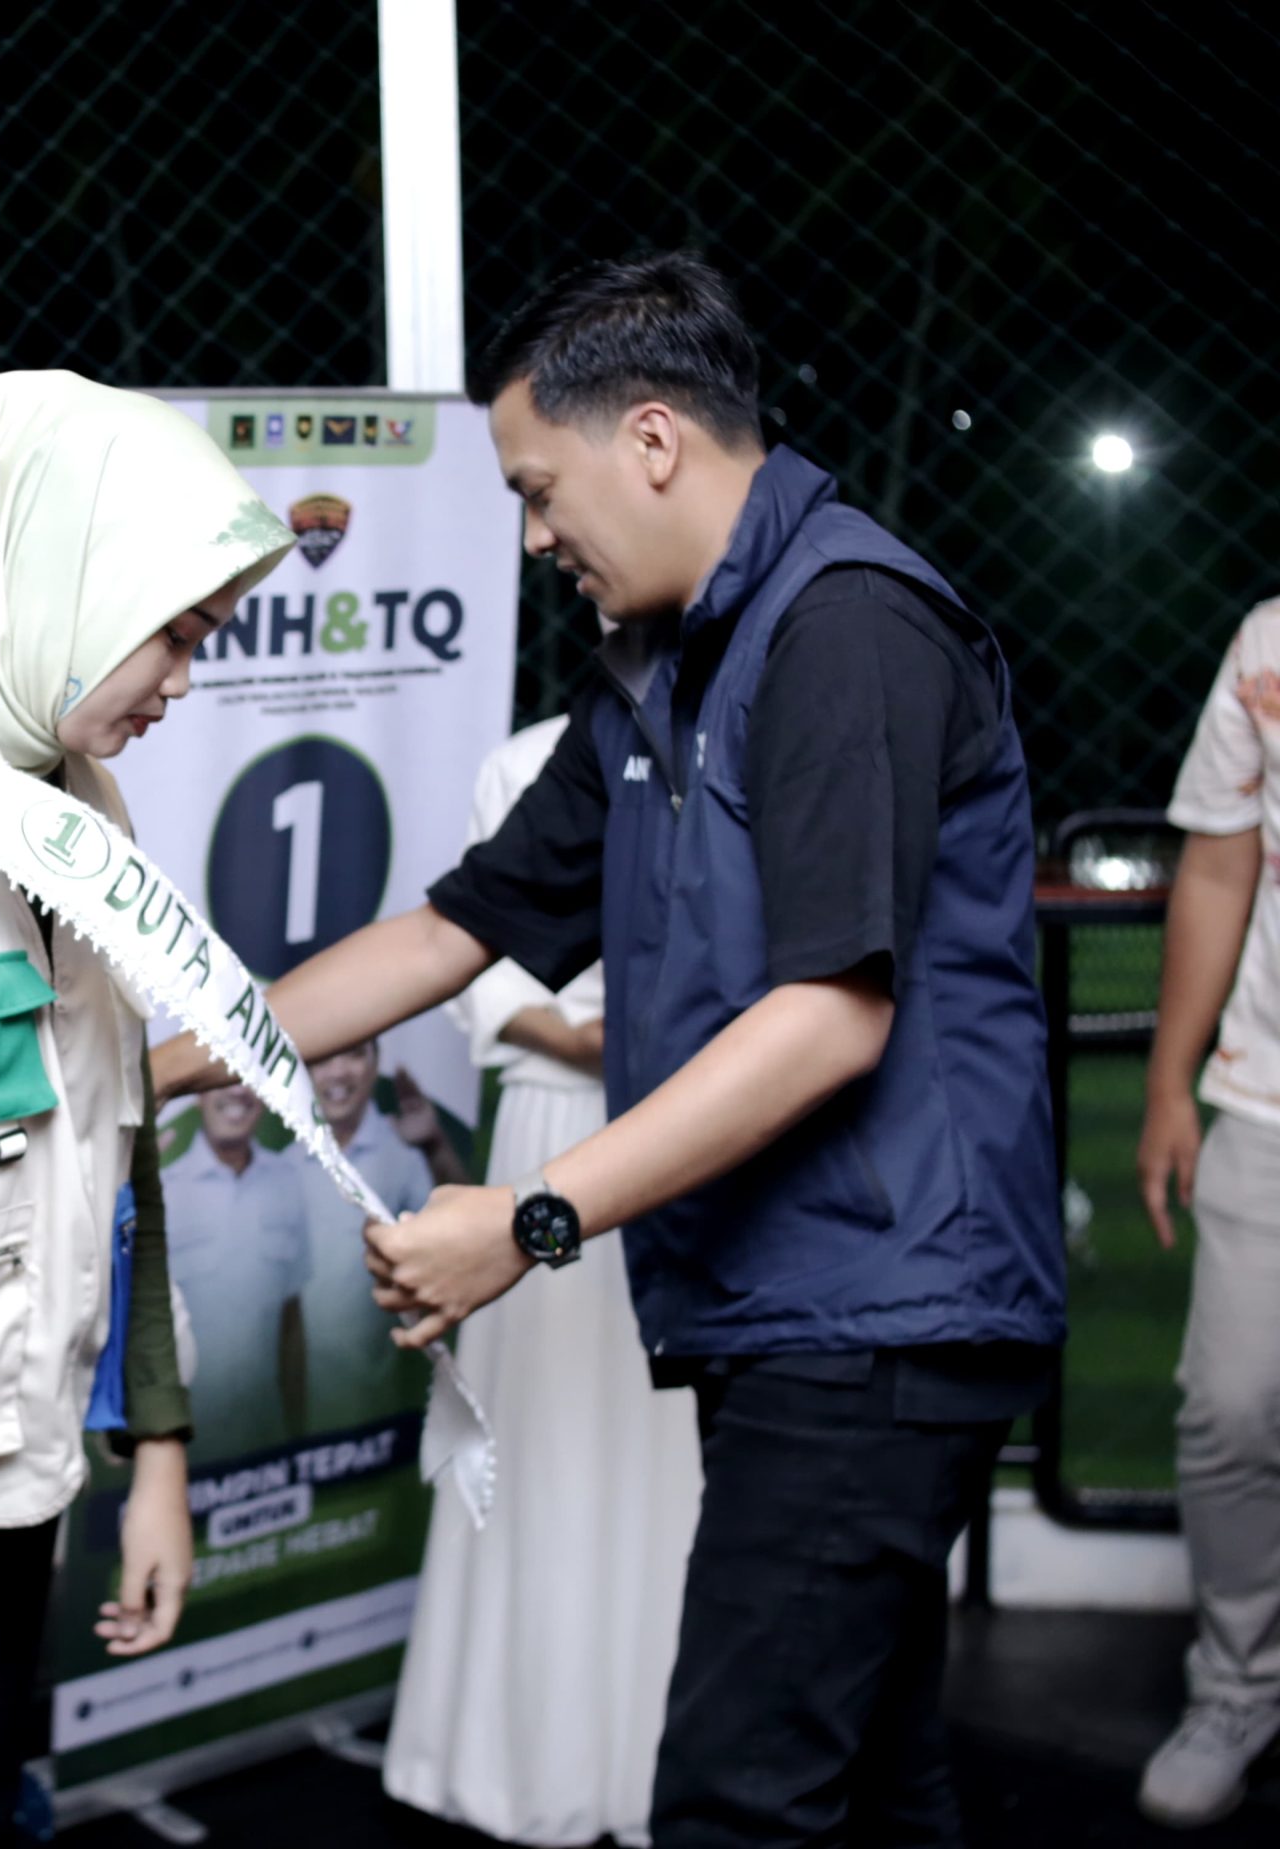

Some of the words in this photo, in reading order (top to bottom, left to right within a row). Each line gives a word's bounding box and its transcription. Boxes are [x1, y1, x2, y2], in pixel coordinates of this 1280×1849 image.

[192, 588, 463, 662] NH&TQ
[42, 811, 87, 868] 1
[272, 780, 323, 945] 1
[104, 855, 212, 989] DUTA
[225, 982, 299, 1088] ANH
[293, 1428, 398, 1482] TEPAT
